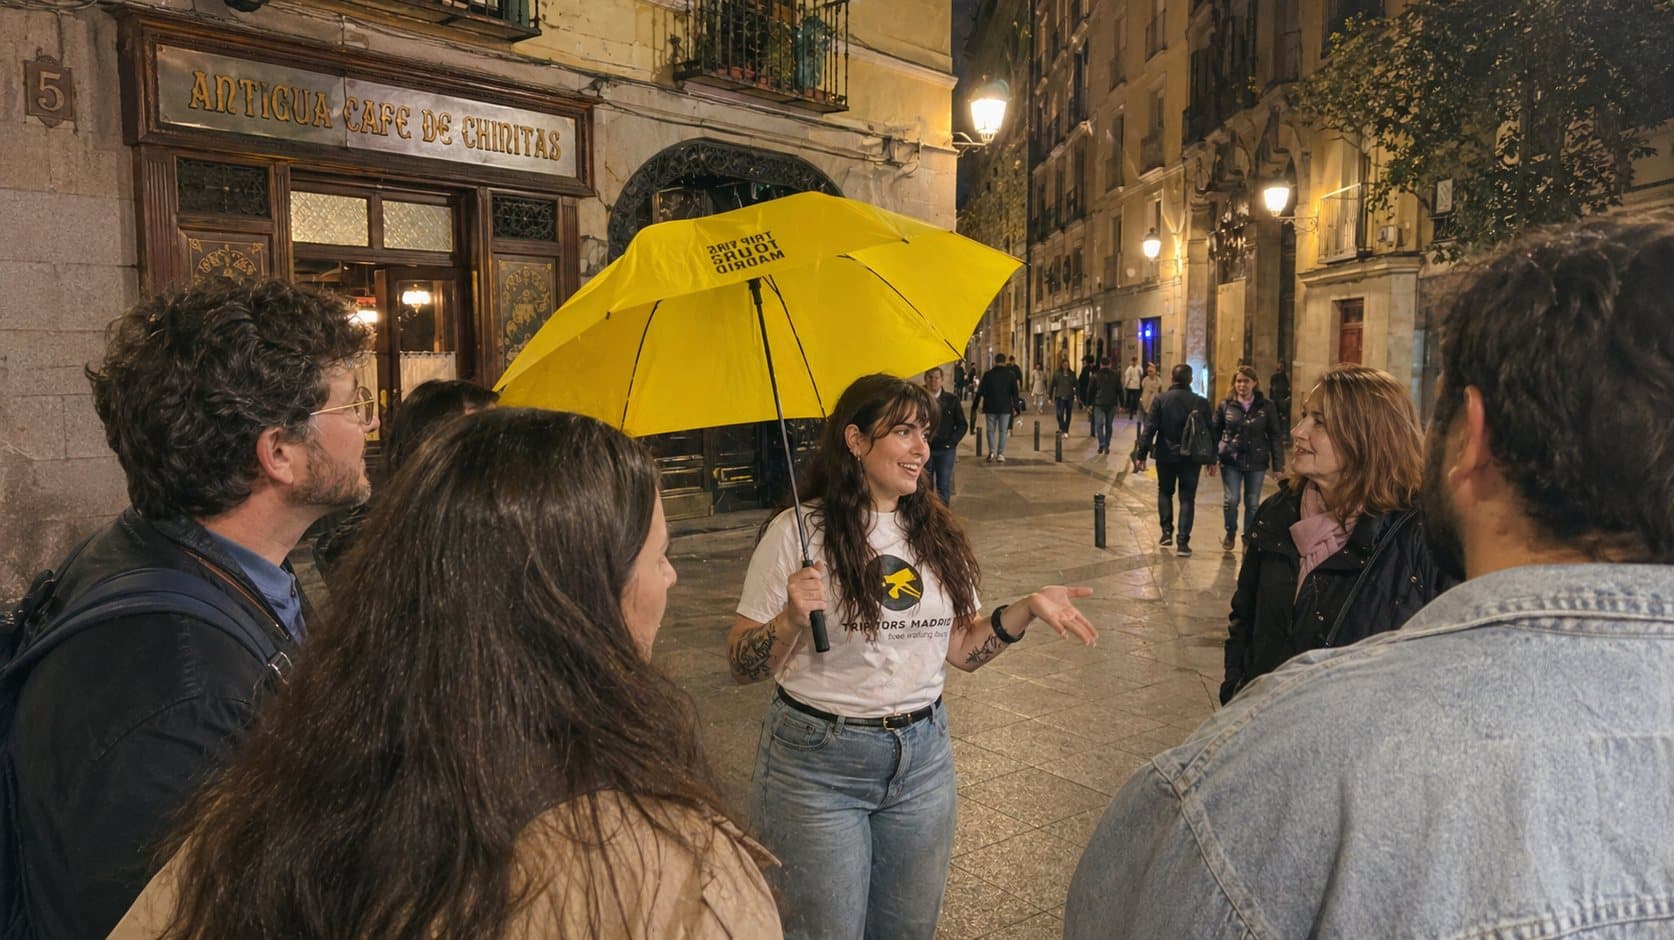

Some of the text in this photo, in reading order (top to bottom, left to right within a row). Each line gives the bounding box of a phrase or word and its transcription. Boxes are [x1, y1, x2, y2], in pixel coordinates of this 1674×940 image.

[38, 70, 65, 112] 5
[188, 71, 562, 162] ANTIGUA CAFE DE CHINITAS
[911, 617, 952, 629] MADRID
